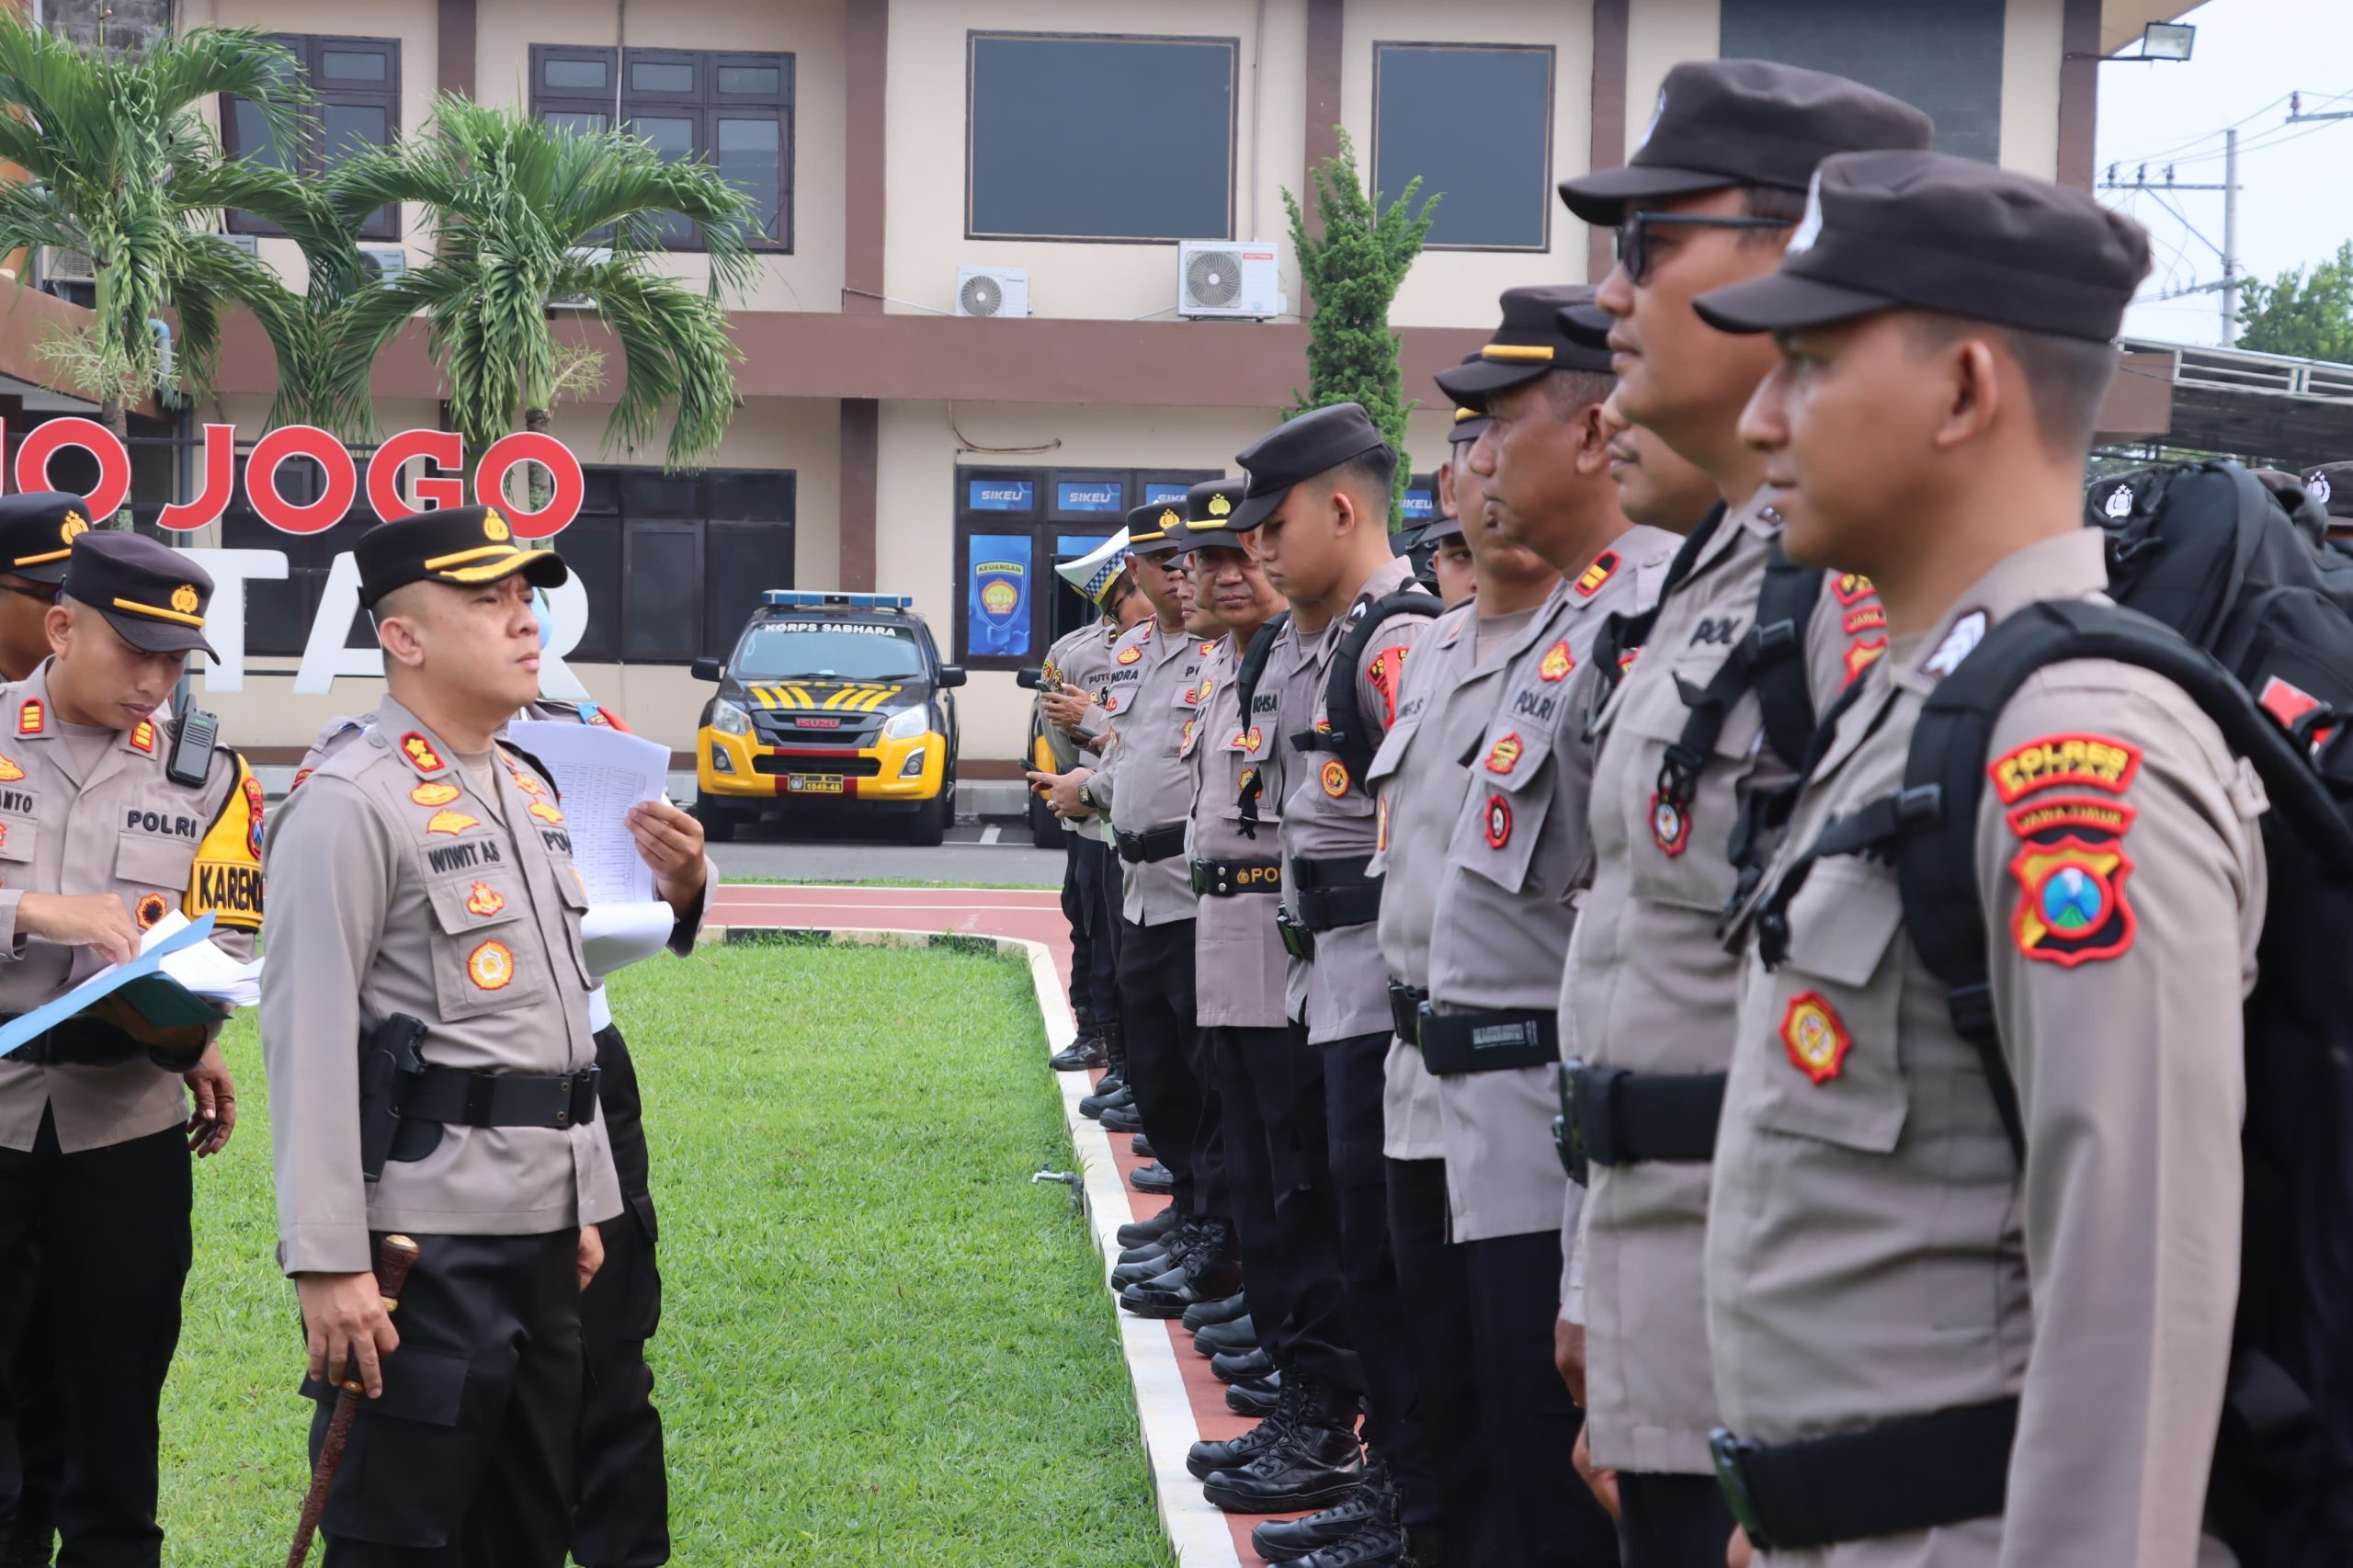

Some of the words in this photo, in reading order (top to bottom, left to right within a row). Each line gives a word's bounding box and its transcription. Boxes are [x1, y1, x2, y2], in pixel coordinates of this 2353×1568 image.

[155, 423, 585, 540] JOGO
[981, 490, 1022, 501] SIKEU
[1069, 492, 1111, 503] SIKEU
[1399, 499, 1433, 508] IKEU
[978, 564, 1022, 573] KEUANGAN
[765, 623, 817, 632] KORPS
[822, 624, 896, 636] SABHARA
[1513, 689, 1557, 722] POLRI
[796, 720, 839, 728] ISUZU
[1999, 739, 2129, 783] POLRES
[0, 790, 33, 813] NTO
[127, 809, 197, 838] POLRI
[428, 841, 479, 873] WIWIT
[480, 840, 501, 863] AS
